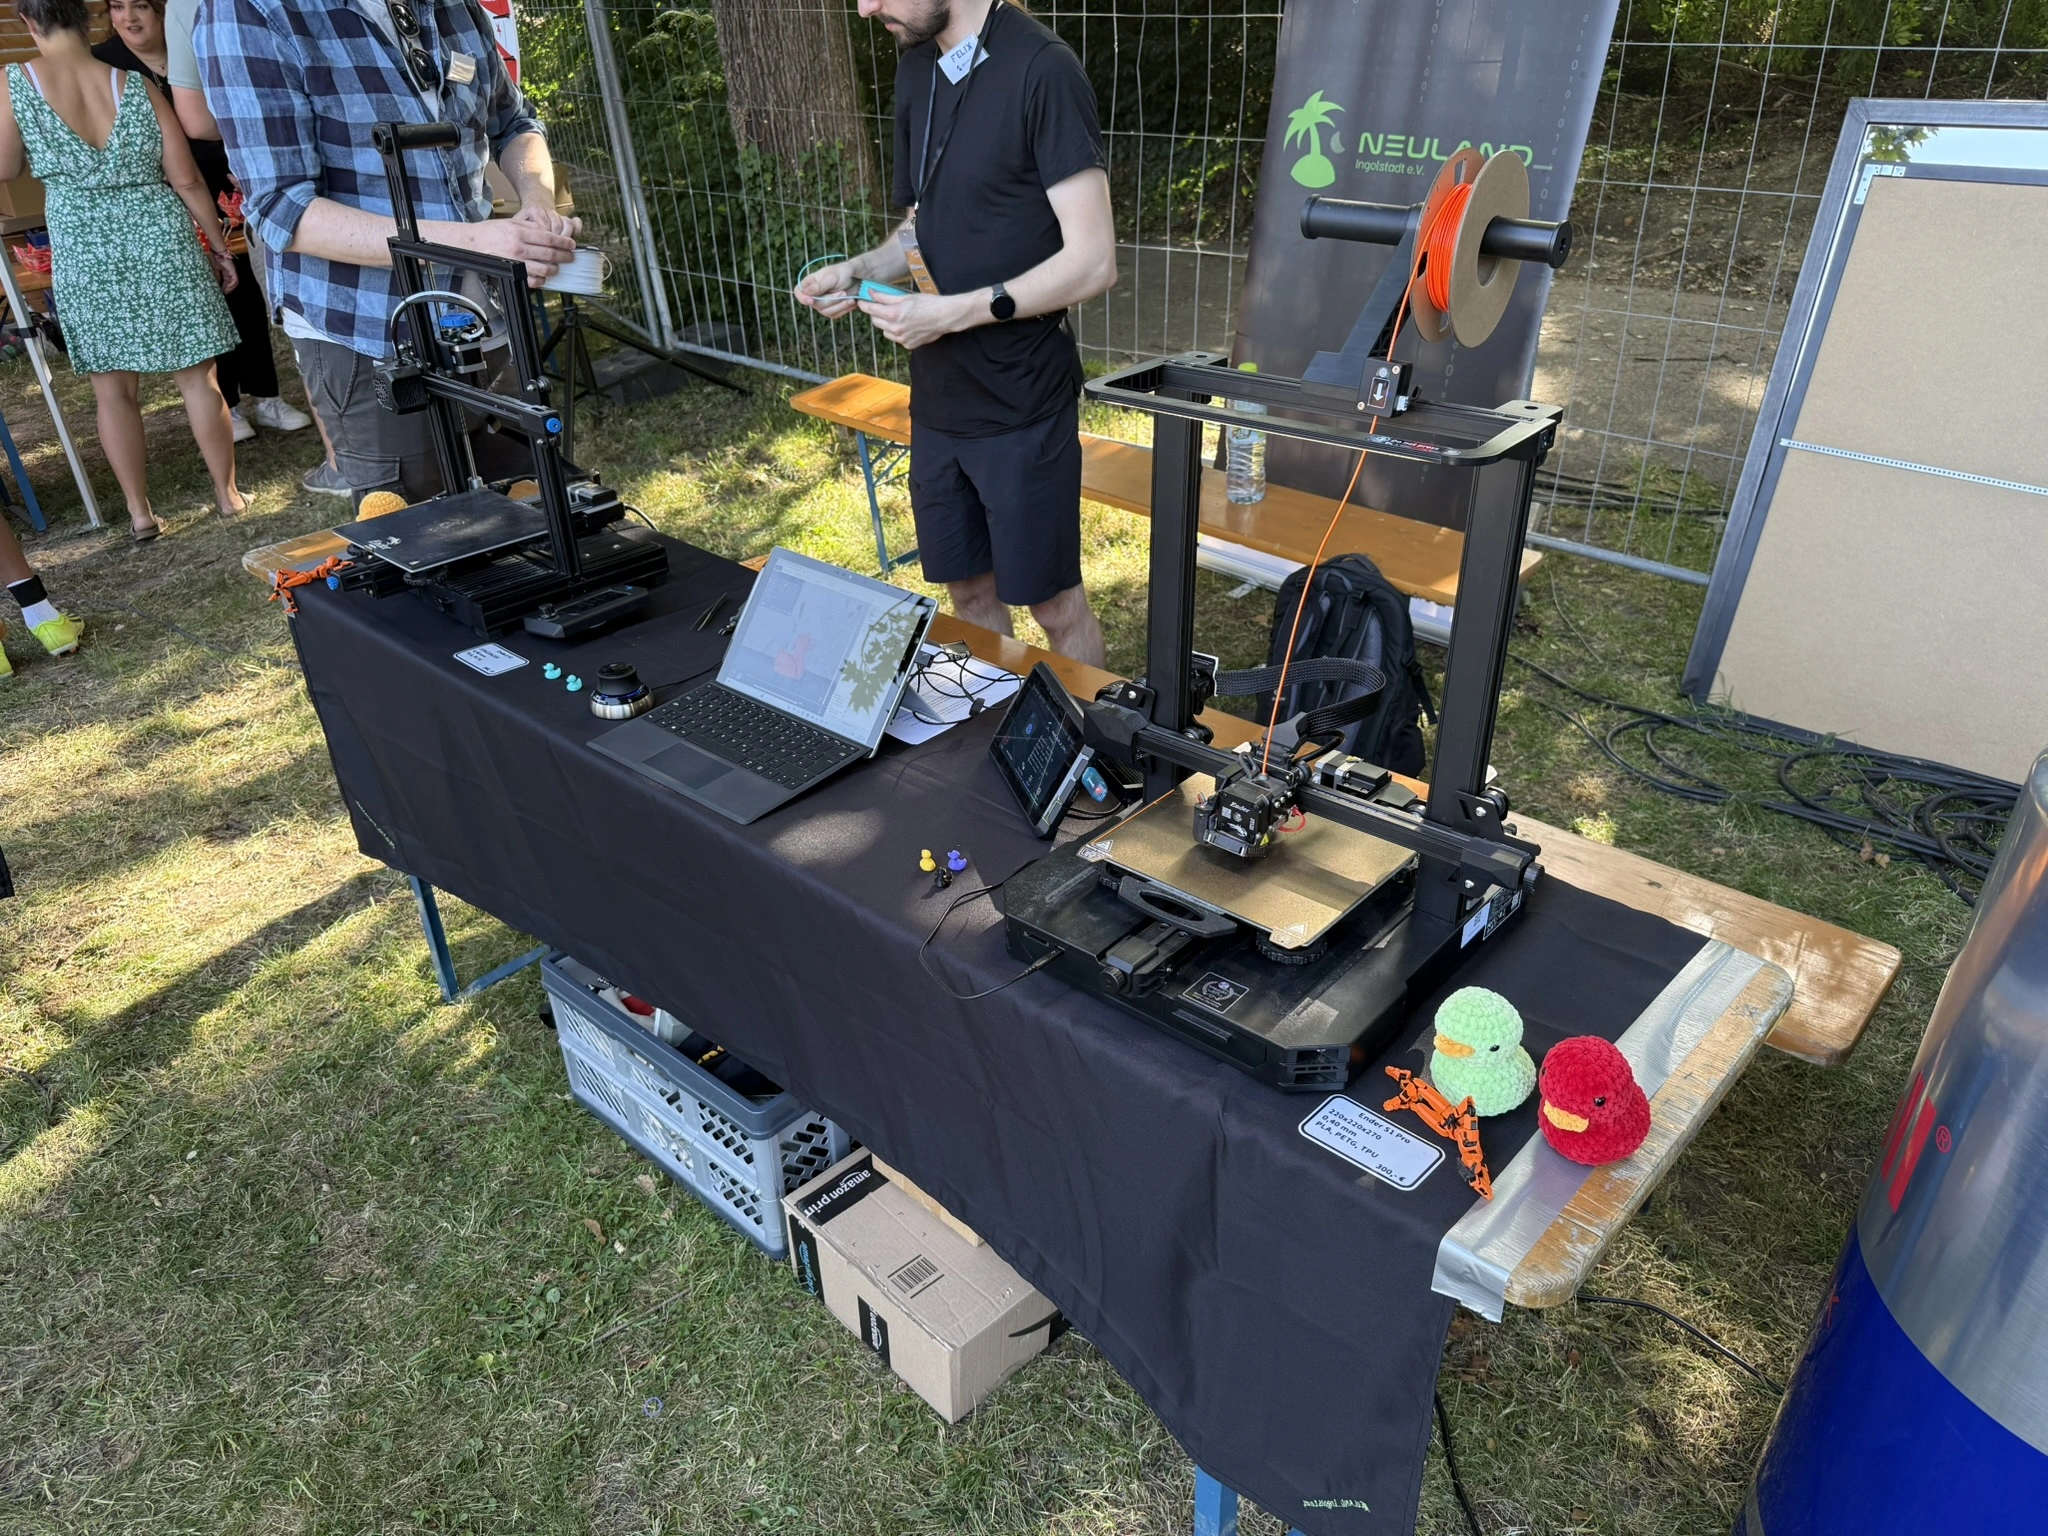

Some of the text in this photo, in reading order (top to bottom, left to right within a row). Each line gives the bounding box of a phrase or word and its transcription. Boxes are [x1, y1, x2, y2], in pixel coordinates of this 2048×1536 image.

[951, 42, 973, 63] FELIX
[1355, 159, 1425, 176] Ingolstadt e.V.
[1230, 802, 1251, 813] Ender
[1315, 1120, 1379, 1159] PLA, PETG, TPU
[1328, 1108, 1382, 1141] 220x220x270
[1341, 1126, 1357, 1137] mm
[1358, 1112, 1411, 1144] Ender S1 Pro
[829, 1169, 871, 1199] amazon
[870, 1312, 882, 1350] amazon
